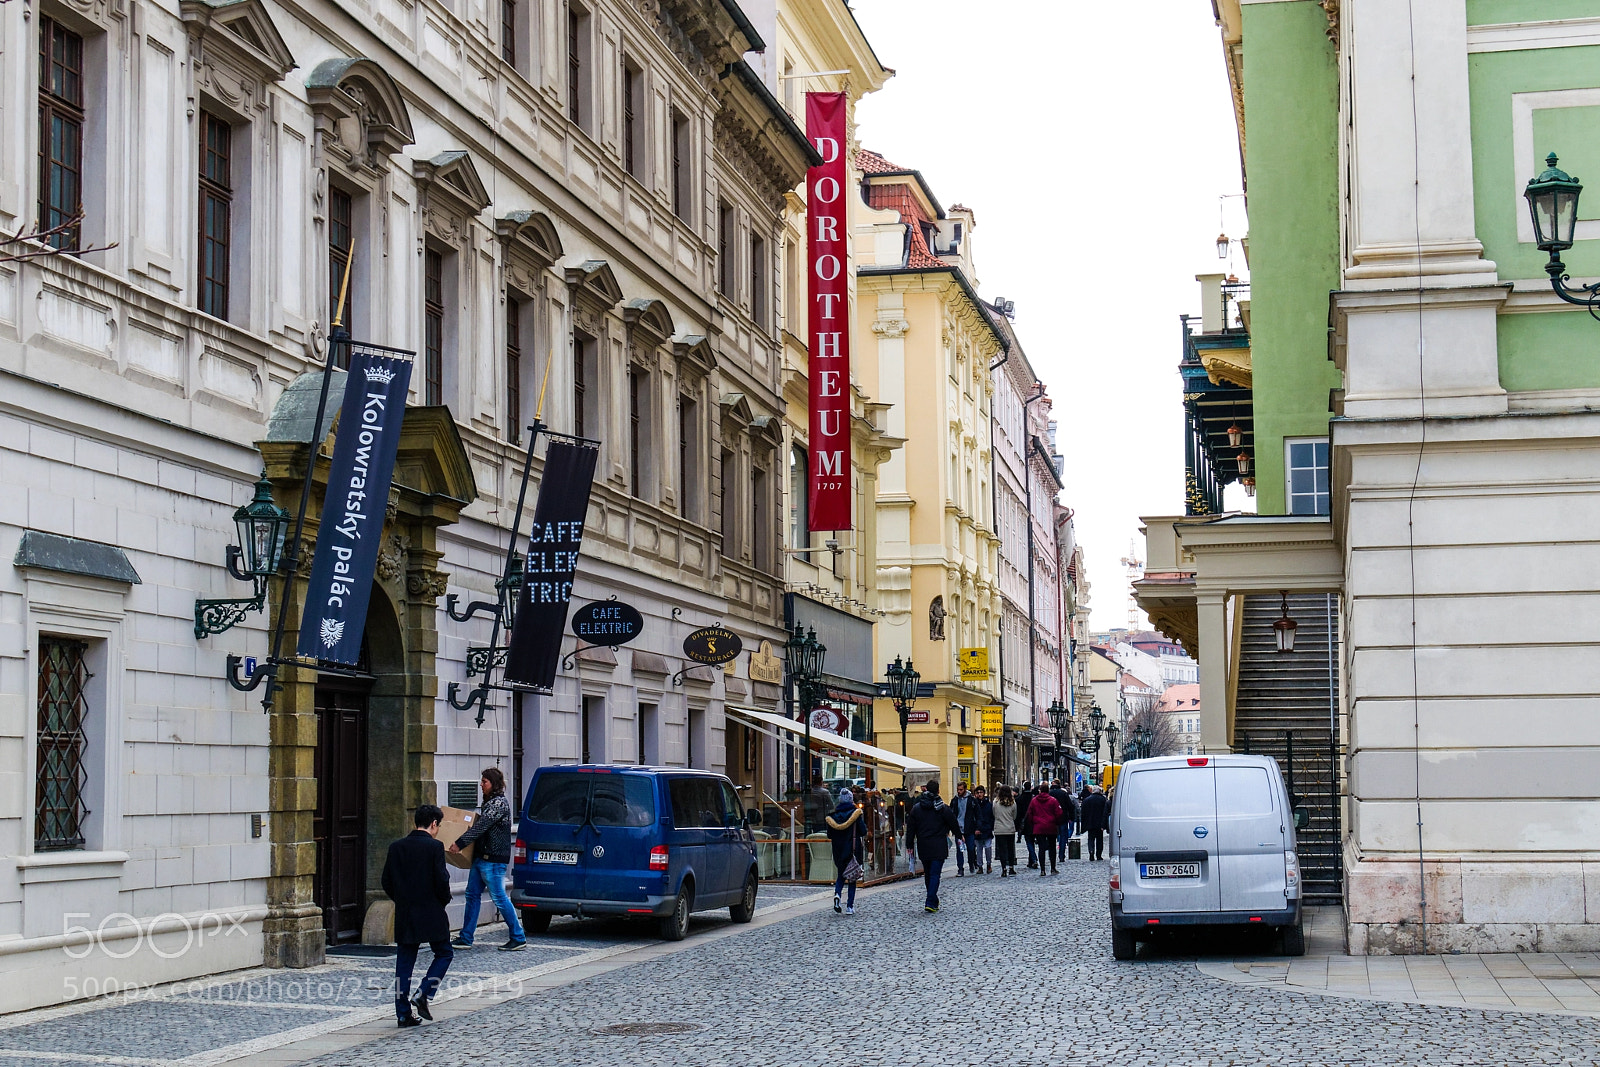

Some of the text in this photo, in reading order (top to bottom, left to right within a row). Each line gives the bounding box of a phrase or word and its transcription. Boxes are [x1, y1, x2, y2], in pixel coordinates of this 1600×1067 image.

[813, 137, 845, 477] DOROTHEUM
[817, 482, 843, 490] 1707
[327, 392, 387, 608] Kolowratský palác
[530, 521, 582, 543] CAFE
[527, 551, 579, 573] ELEK
[527, 581, 573, 604] TRIC
[592, 607, 621, 619] CAFE
[580, 622, 633, 634] ELEKTRIC
[691, 629, 734, 641] DIVADELNÍ
[689, 649, 736, 662] RESTAURACE
[539, 852, 576, 862] 3AY 9834
[1147, 864, 1196, 876] 6AS 2640
